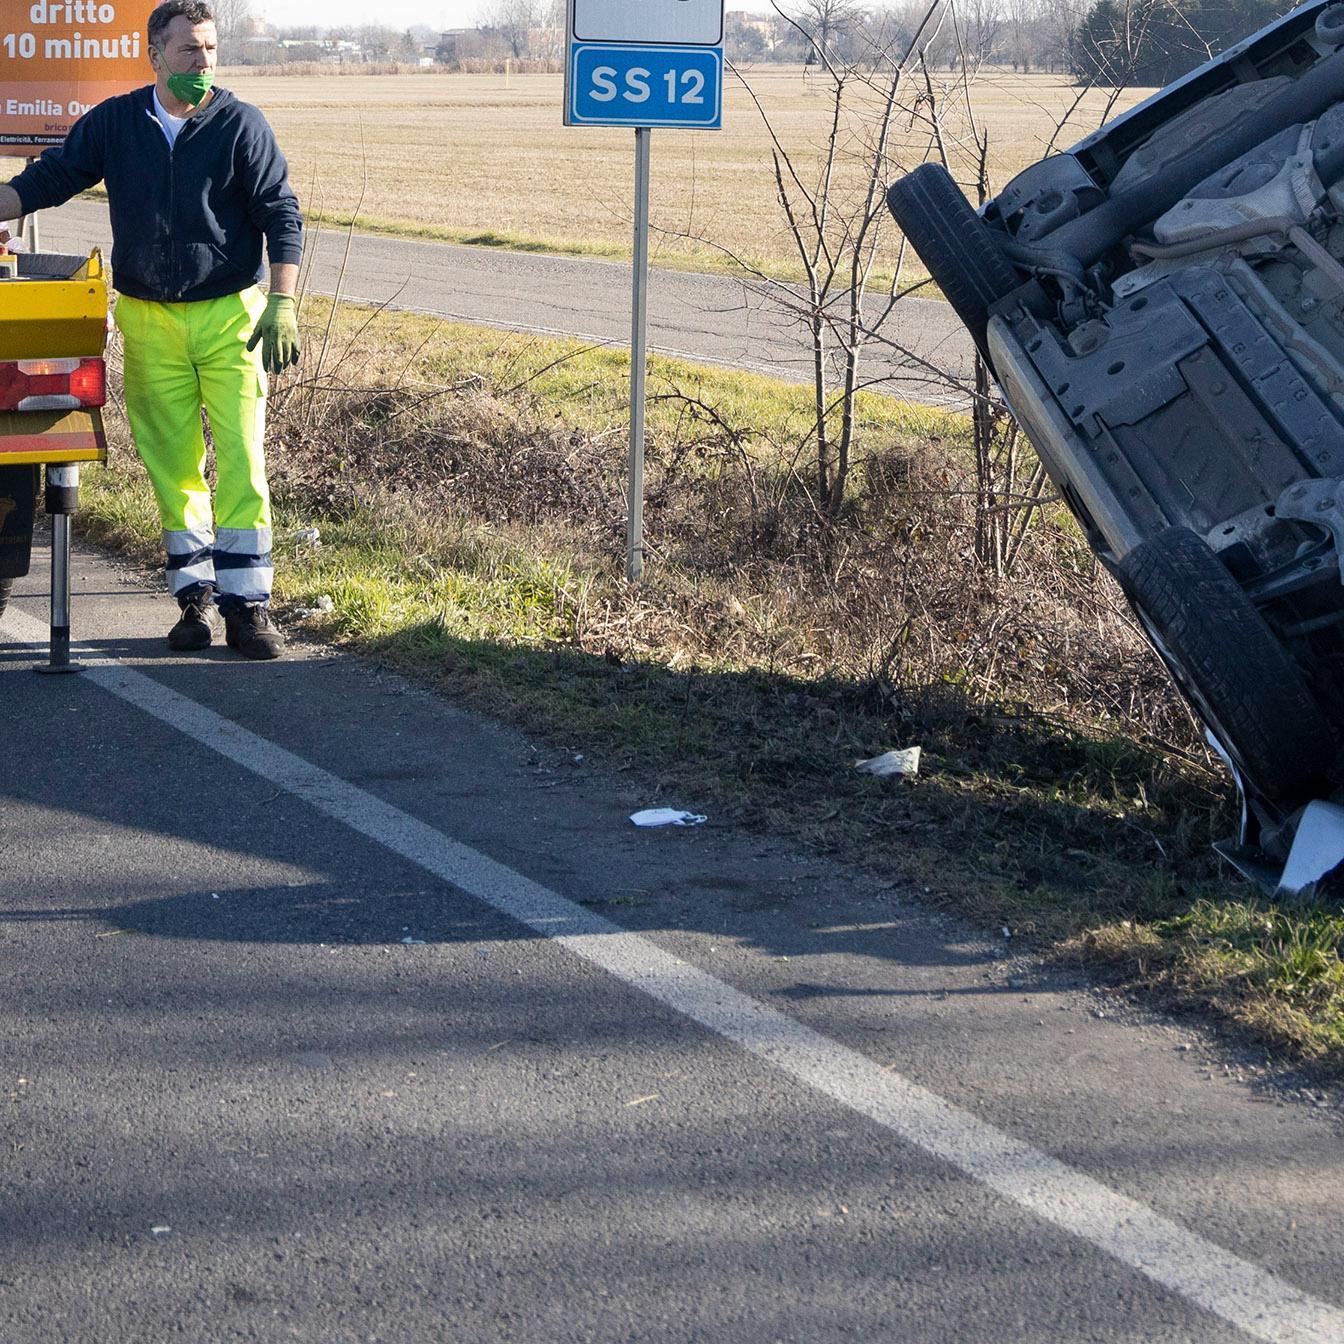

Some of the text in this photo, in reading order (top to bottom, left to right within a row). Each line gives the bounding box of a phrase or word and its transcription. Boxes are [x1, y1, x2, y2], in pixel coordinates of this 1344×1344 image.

[3, 32, 140, 60] 10 minuti
[588, 65, 705, 105] SS 12
[6, 99, 62, 116] Emilia
[0, 136, 33, 144] Elettricità,
